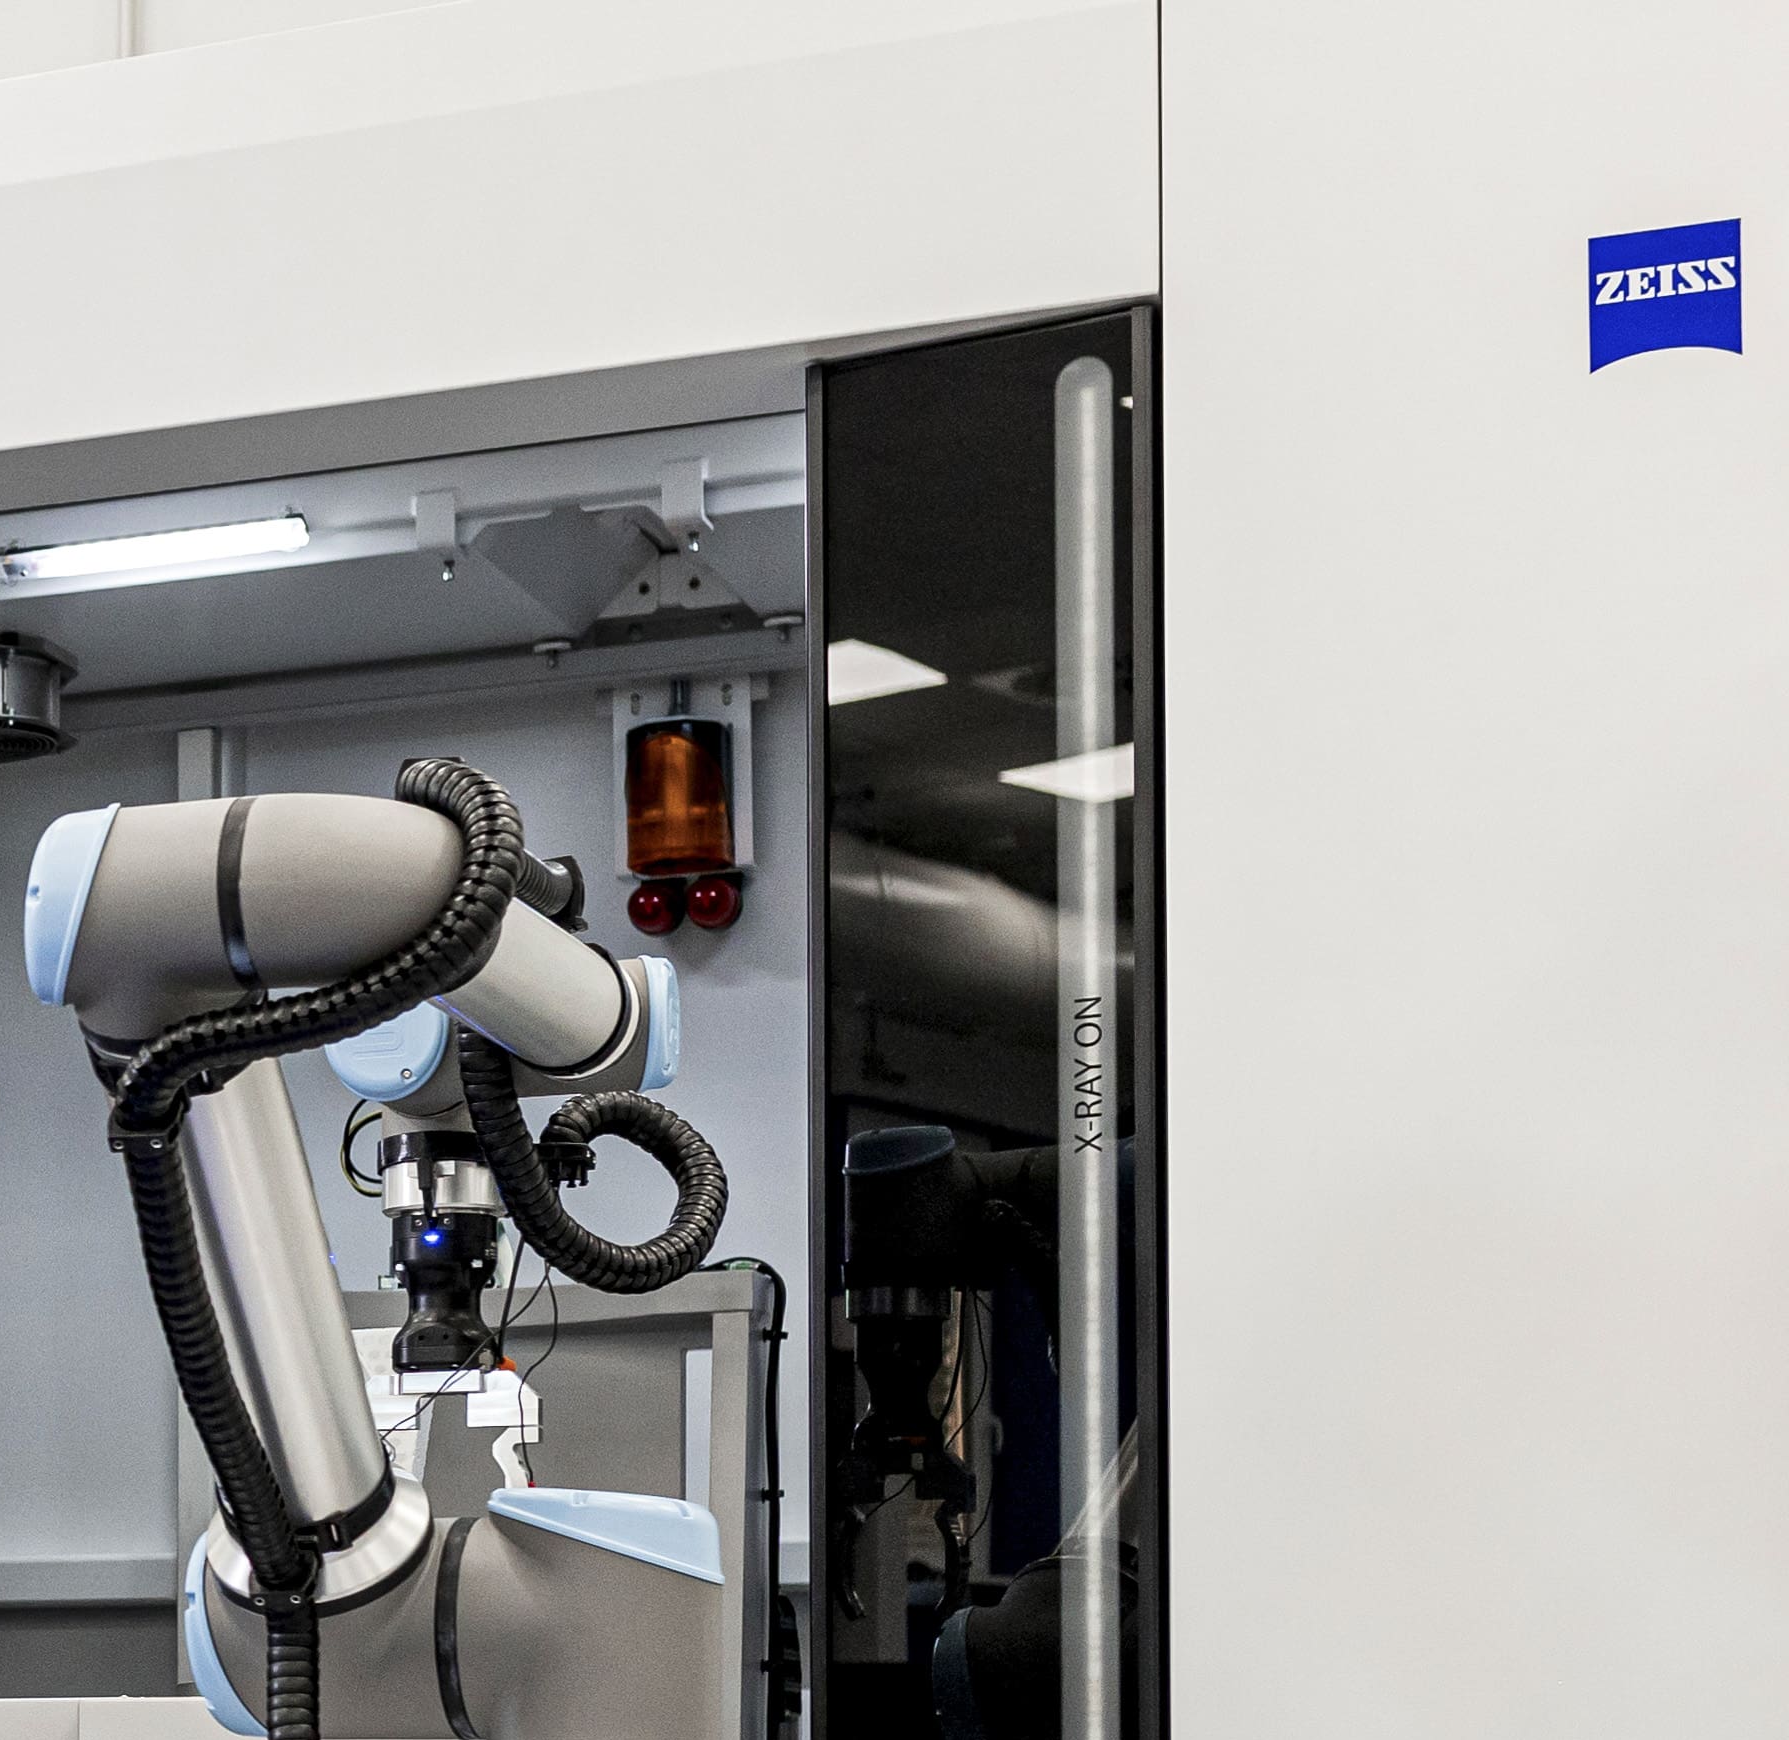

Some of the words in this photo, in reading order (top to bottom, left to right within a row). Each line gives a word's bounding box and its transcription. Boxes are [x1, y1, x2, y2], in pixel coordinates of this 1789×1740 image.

[1595, 255, 1737, 306] ZEISS
[1073, 996, 1103, 1048] ON
[1073, 1058, 1103, 1153] X-RAY
